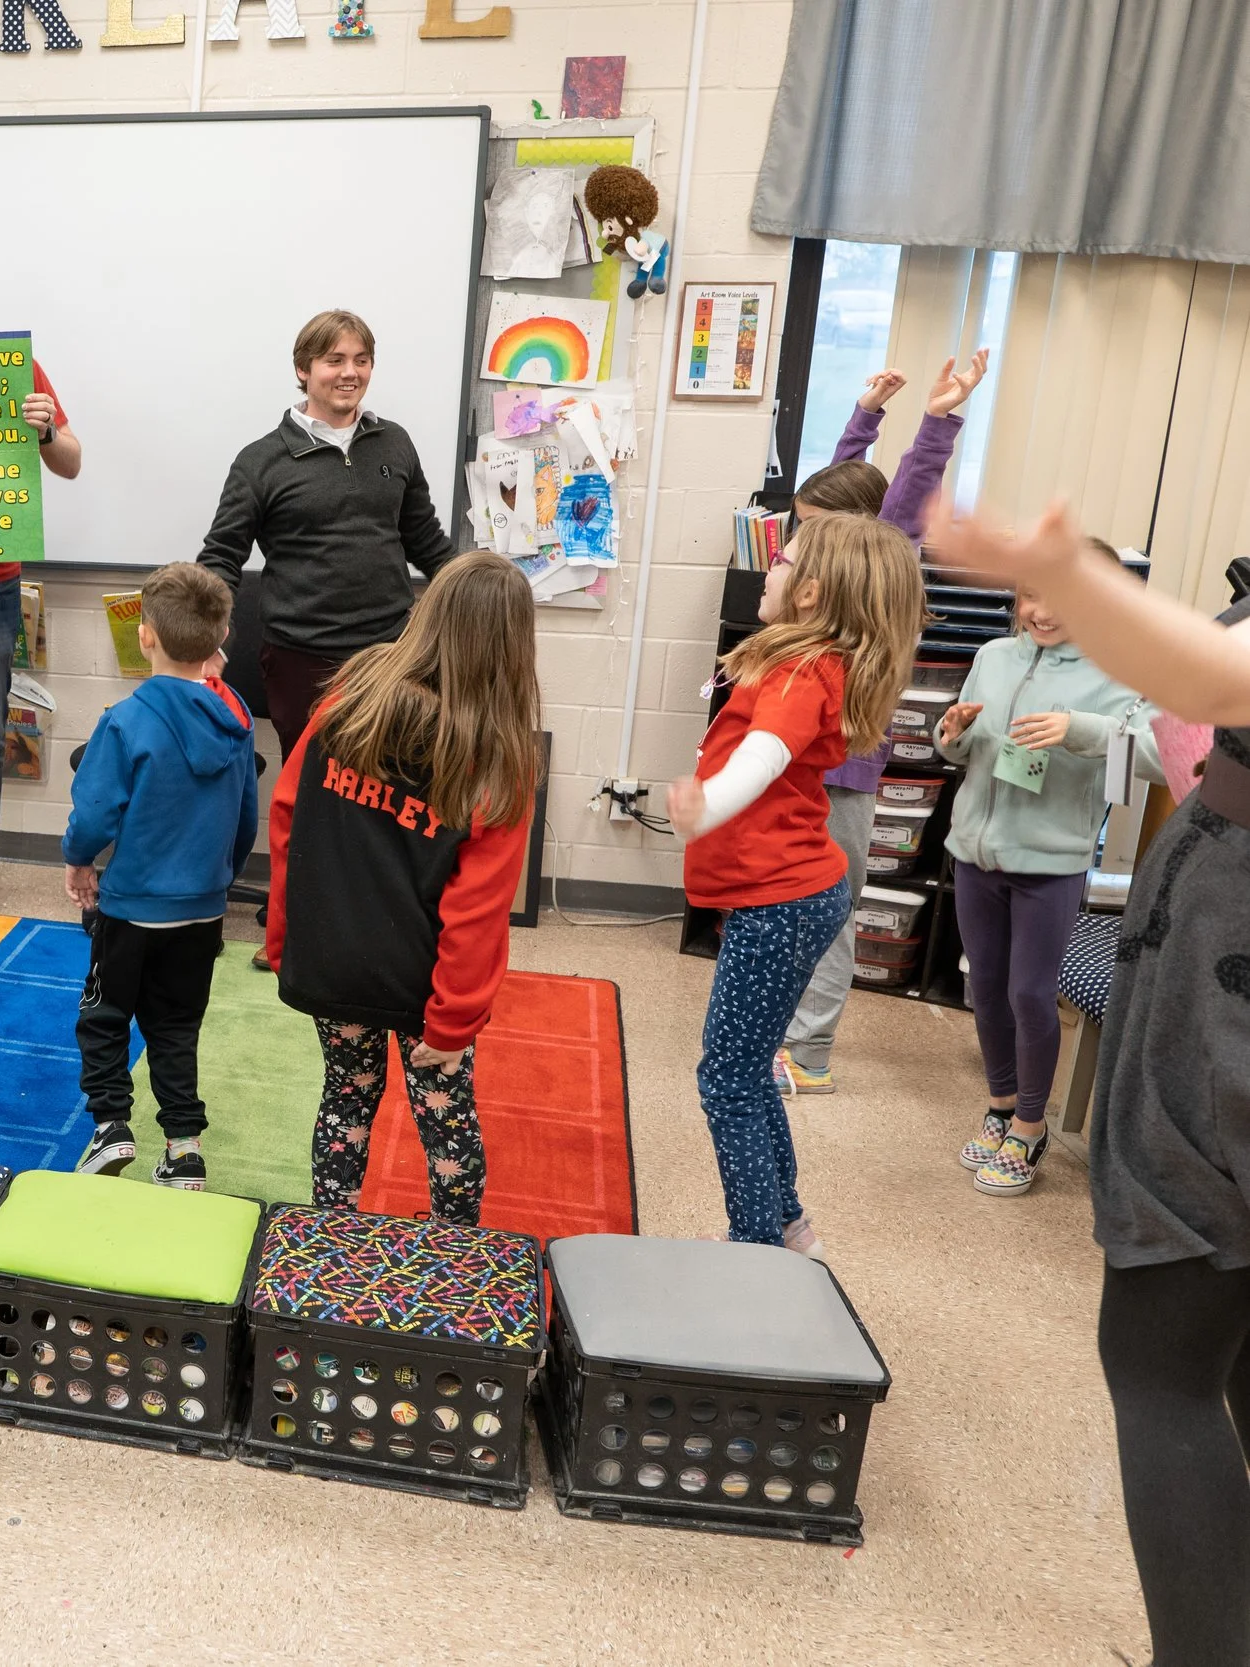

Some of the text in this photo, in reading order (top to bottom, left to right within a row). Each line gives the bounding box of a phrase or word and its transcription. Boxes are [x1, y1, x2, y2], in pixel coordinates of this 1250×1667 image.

[701, 302, 708, 311] 5
[699, 318, 706, 326] 4
[698, 334, 704, 342] 3
[696, 350, 702, 358] 2
[693, 381, 699, 389] 0
[8, 400, 17, 418] I
[109, 600, 142, 622] FLOW
[322, 757, 443, 839] HARLEY
